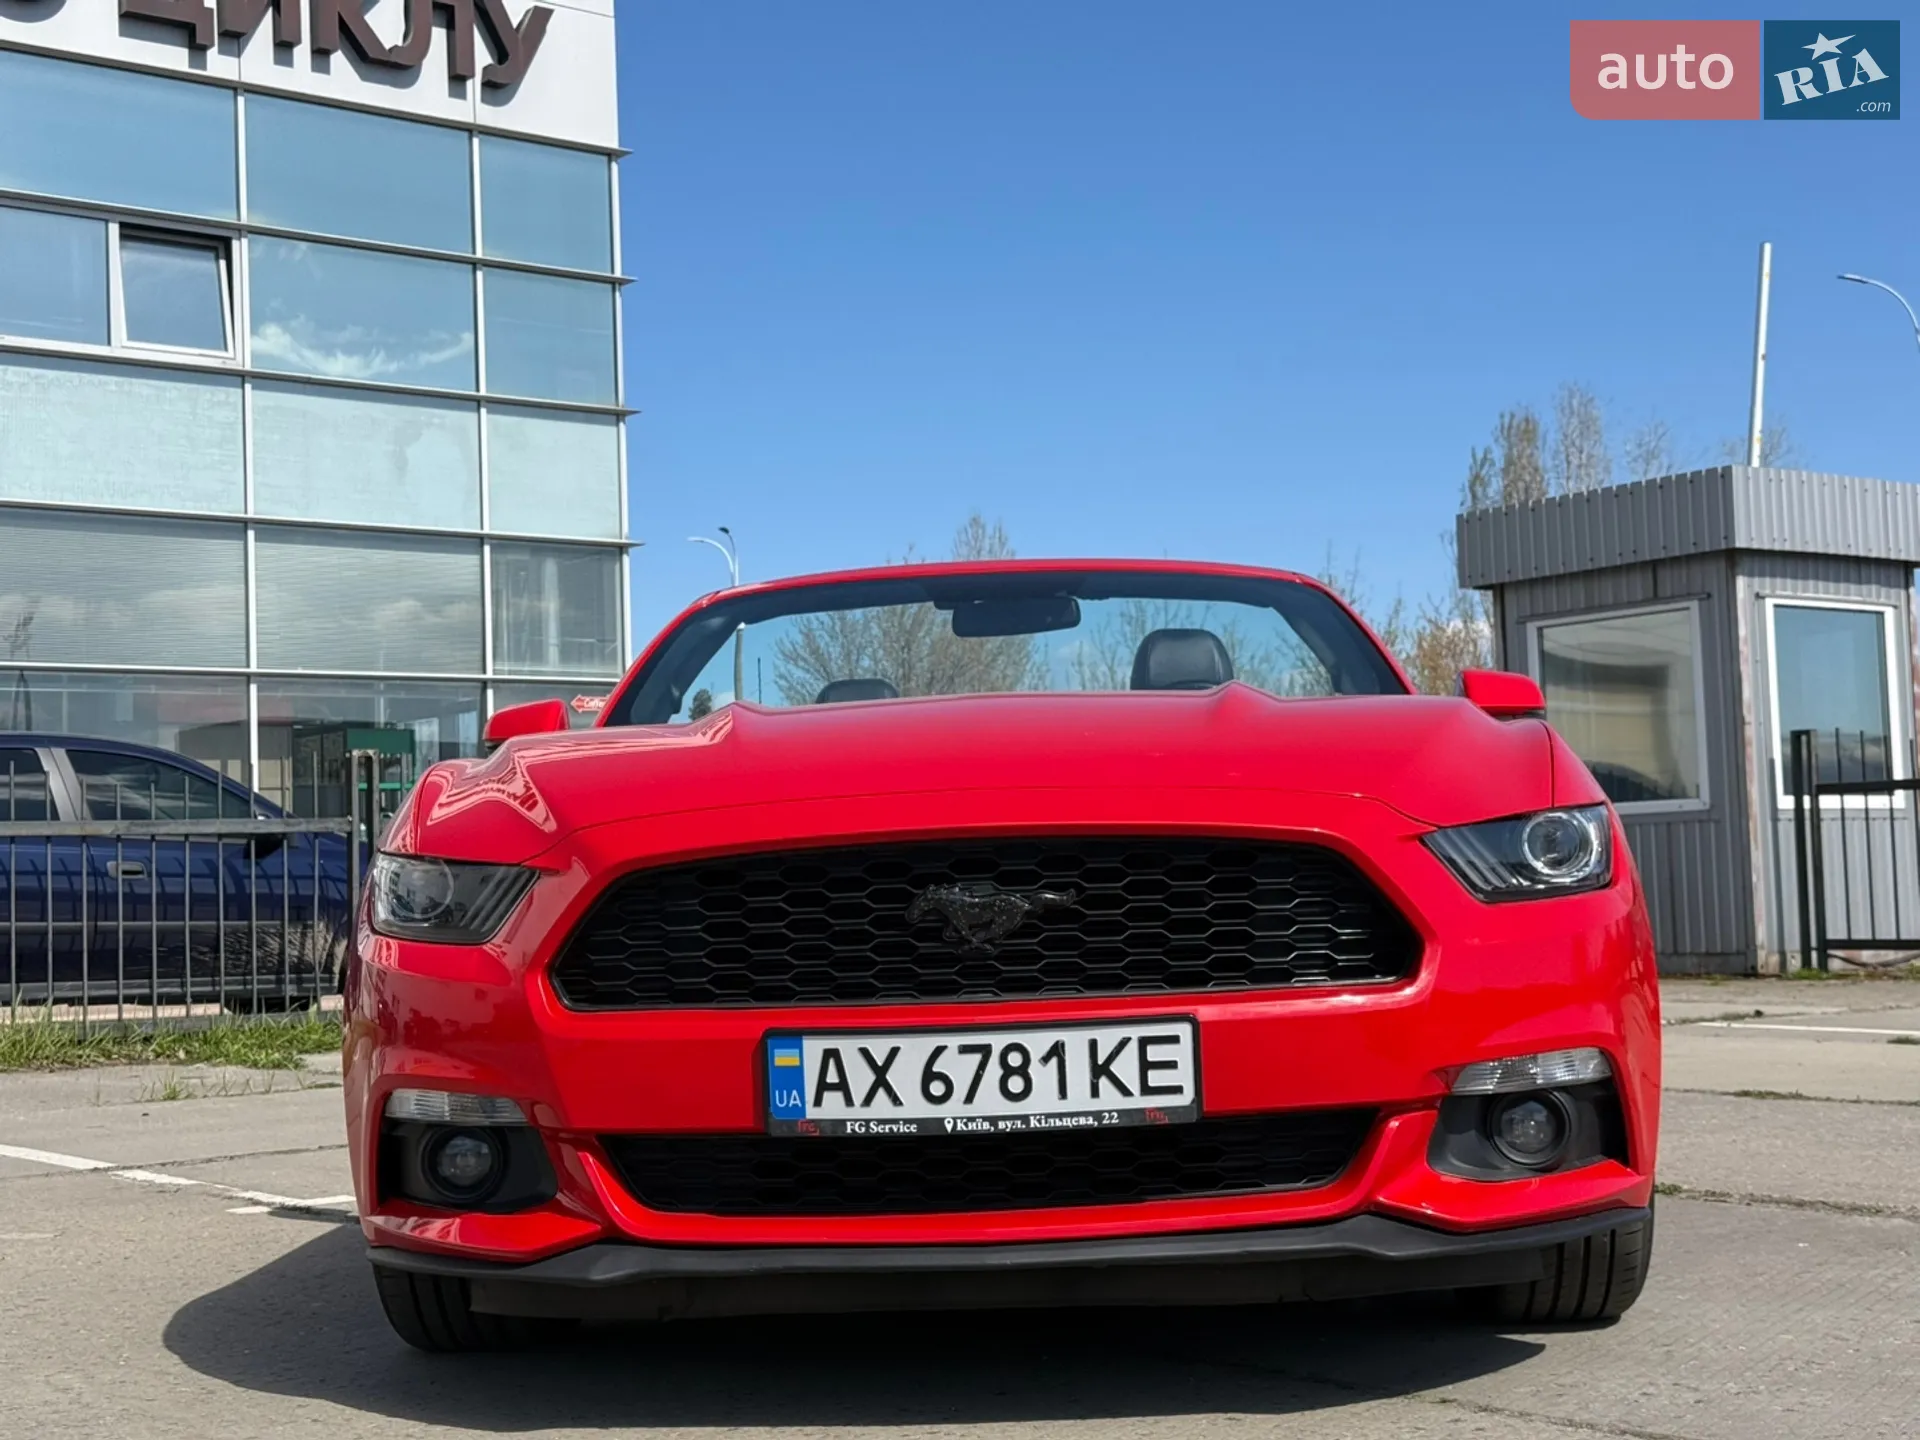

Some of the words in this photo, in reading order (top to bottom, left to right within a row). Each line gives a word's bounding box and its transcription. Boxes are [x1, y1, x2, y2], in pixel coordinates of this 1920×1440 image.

[812, 1045, 905, 1108] AX
[920, 1039, 1068, 1105] 6781
[1089, 1034, 1185, 1099] KE
[775, 1089, 802, 1108] UA
[846, 1121, 866, 1133] FG
[869, 1120, 918, 1133] Service
[955, 1117, 994, 1132] Київ,
[998, 1119, 1026, 1132] вул.
[1029, 1114, 1099, 1129] Кільцева,
[1101, 1112, 1120, 1125] 22
